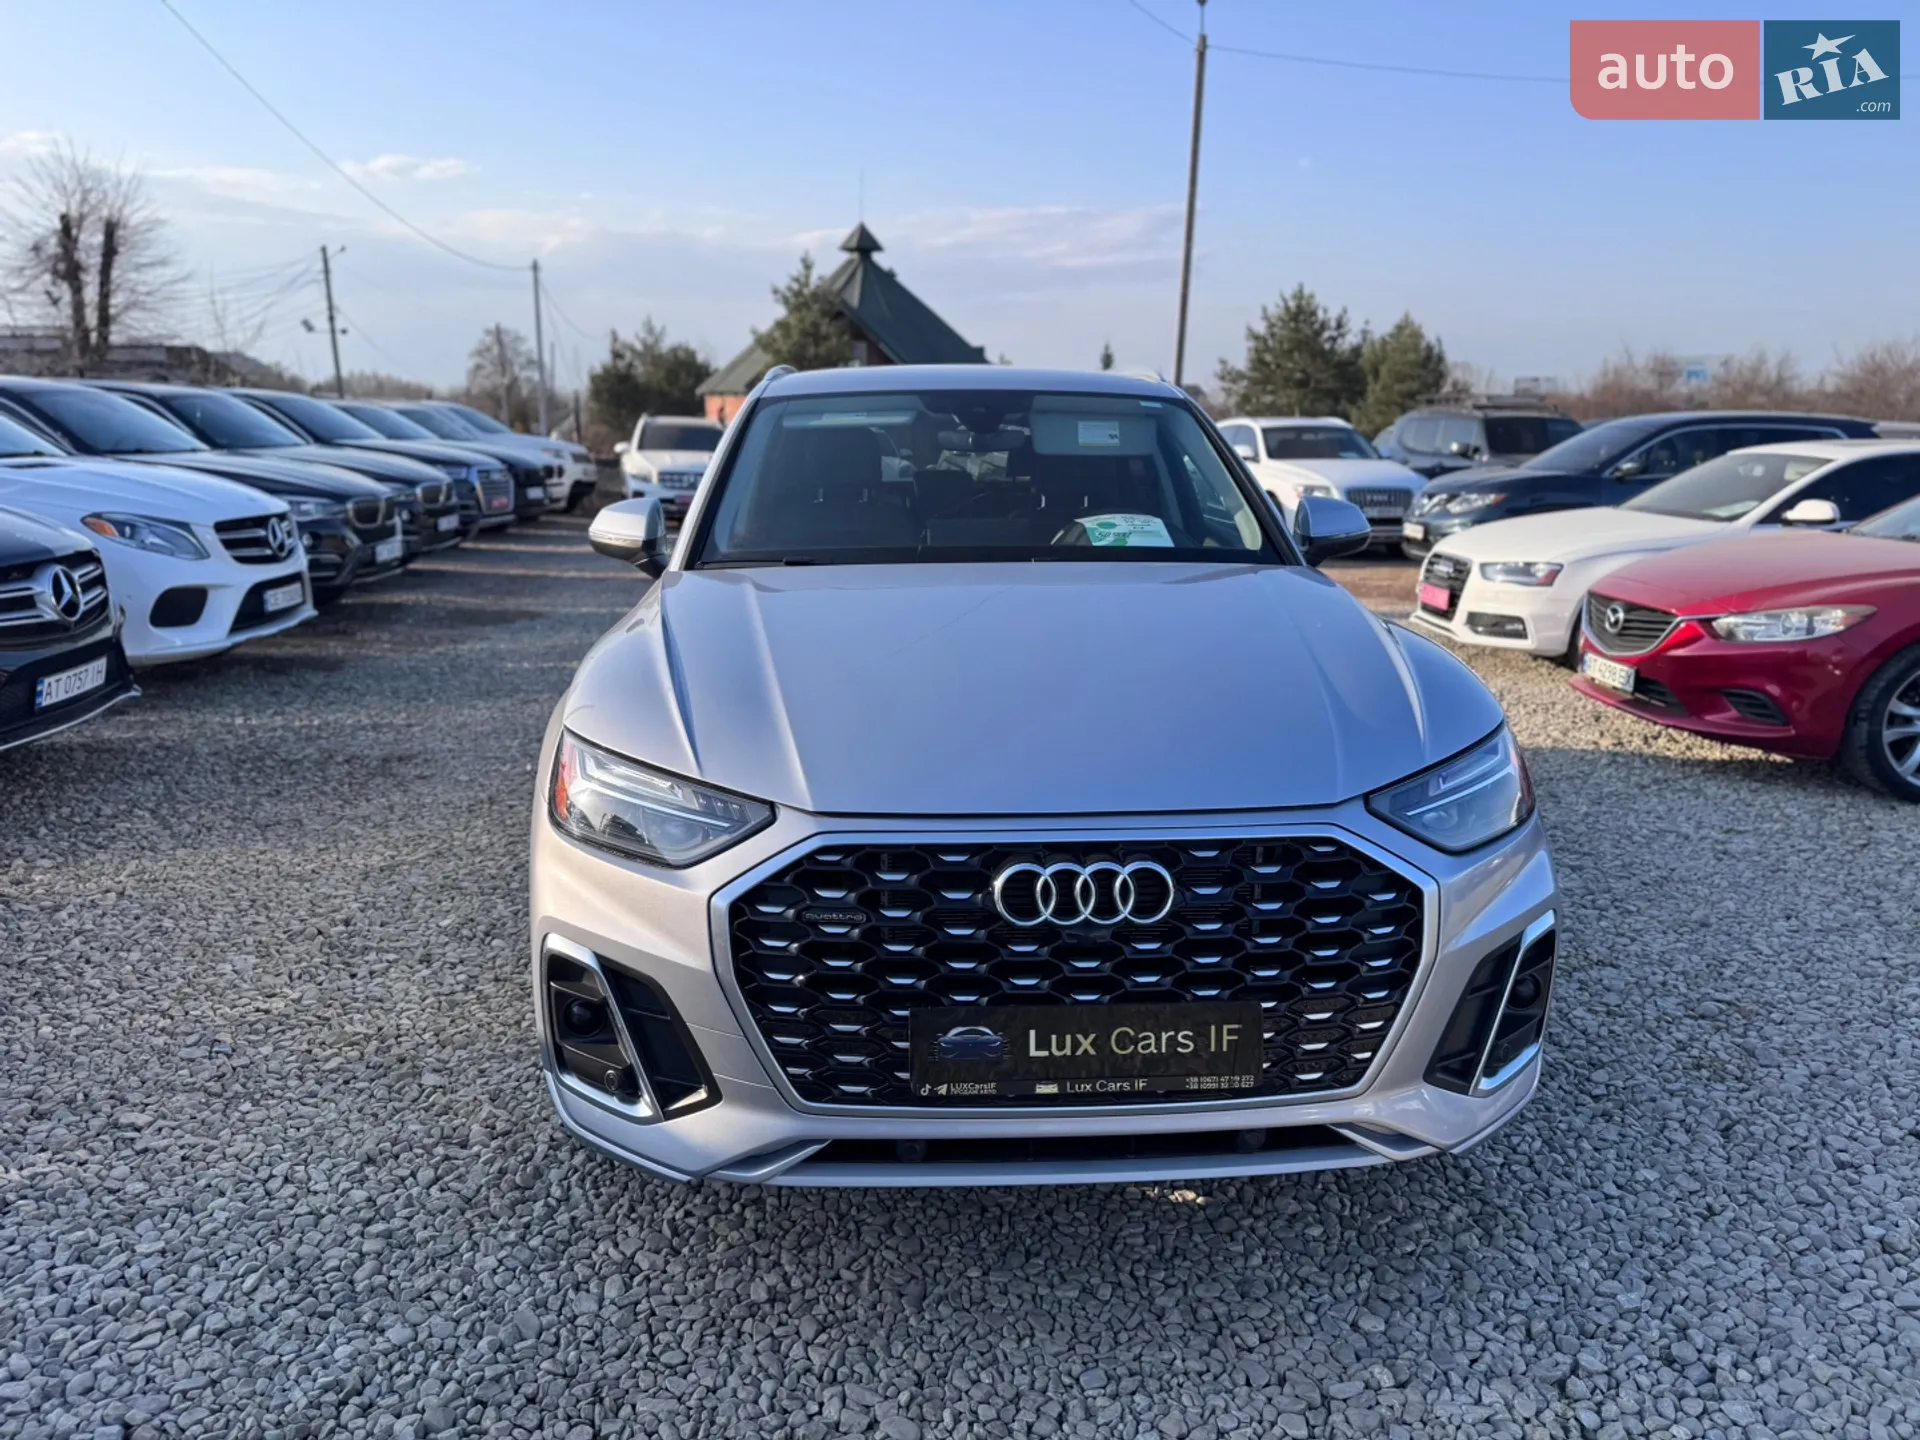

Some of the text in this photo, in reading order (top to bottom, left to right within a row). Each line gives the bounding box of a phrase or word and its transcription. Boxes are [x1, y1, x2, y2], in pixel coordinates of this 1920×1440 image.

[44, 678, 62, 702] AT
[64, 668, 89, 695] 0757
[804, 912, 863, 923] quattro
[1028, 1024, 1242, 1057] Lux Cars IF
[1066, 1078, 1148, 1093] Lux Cars IF
